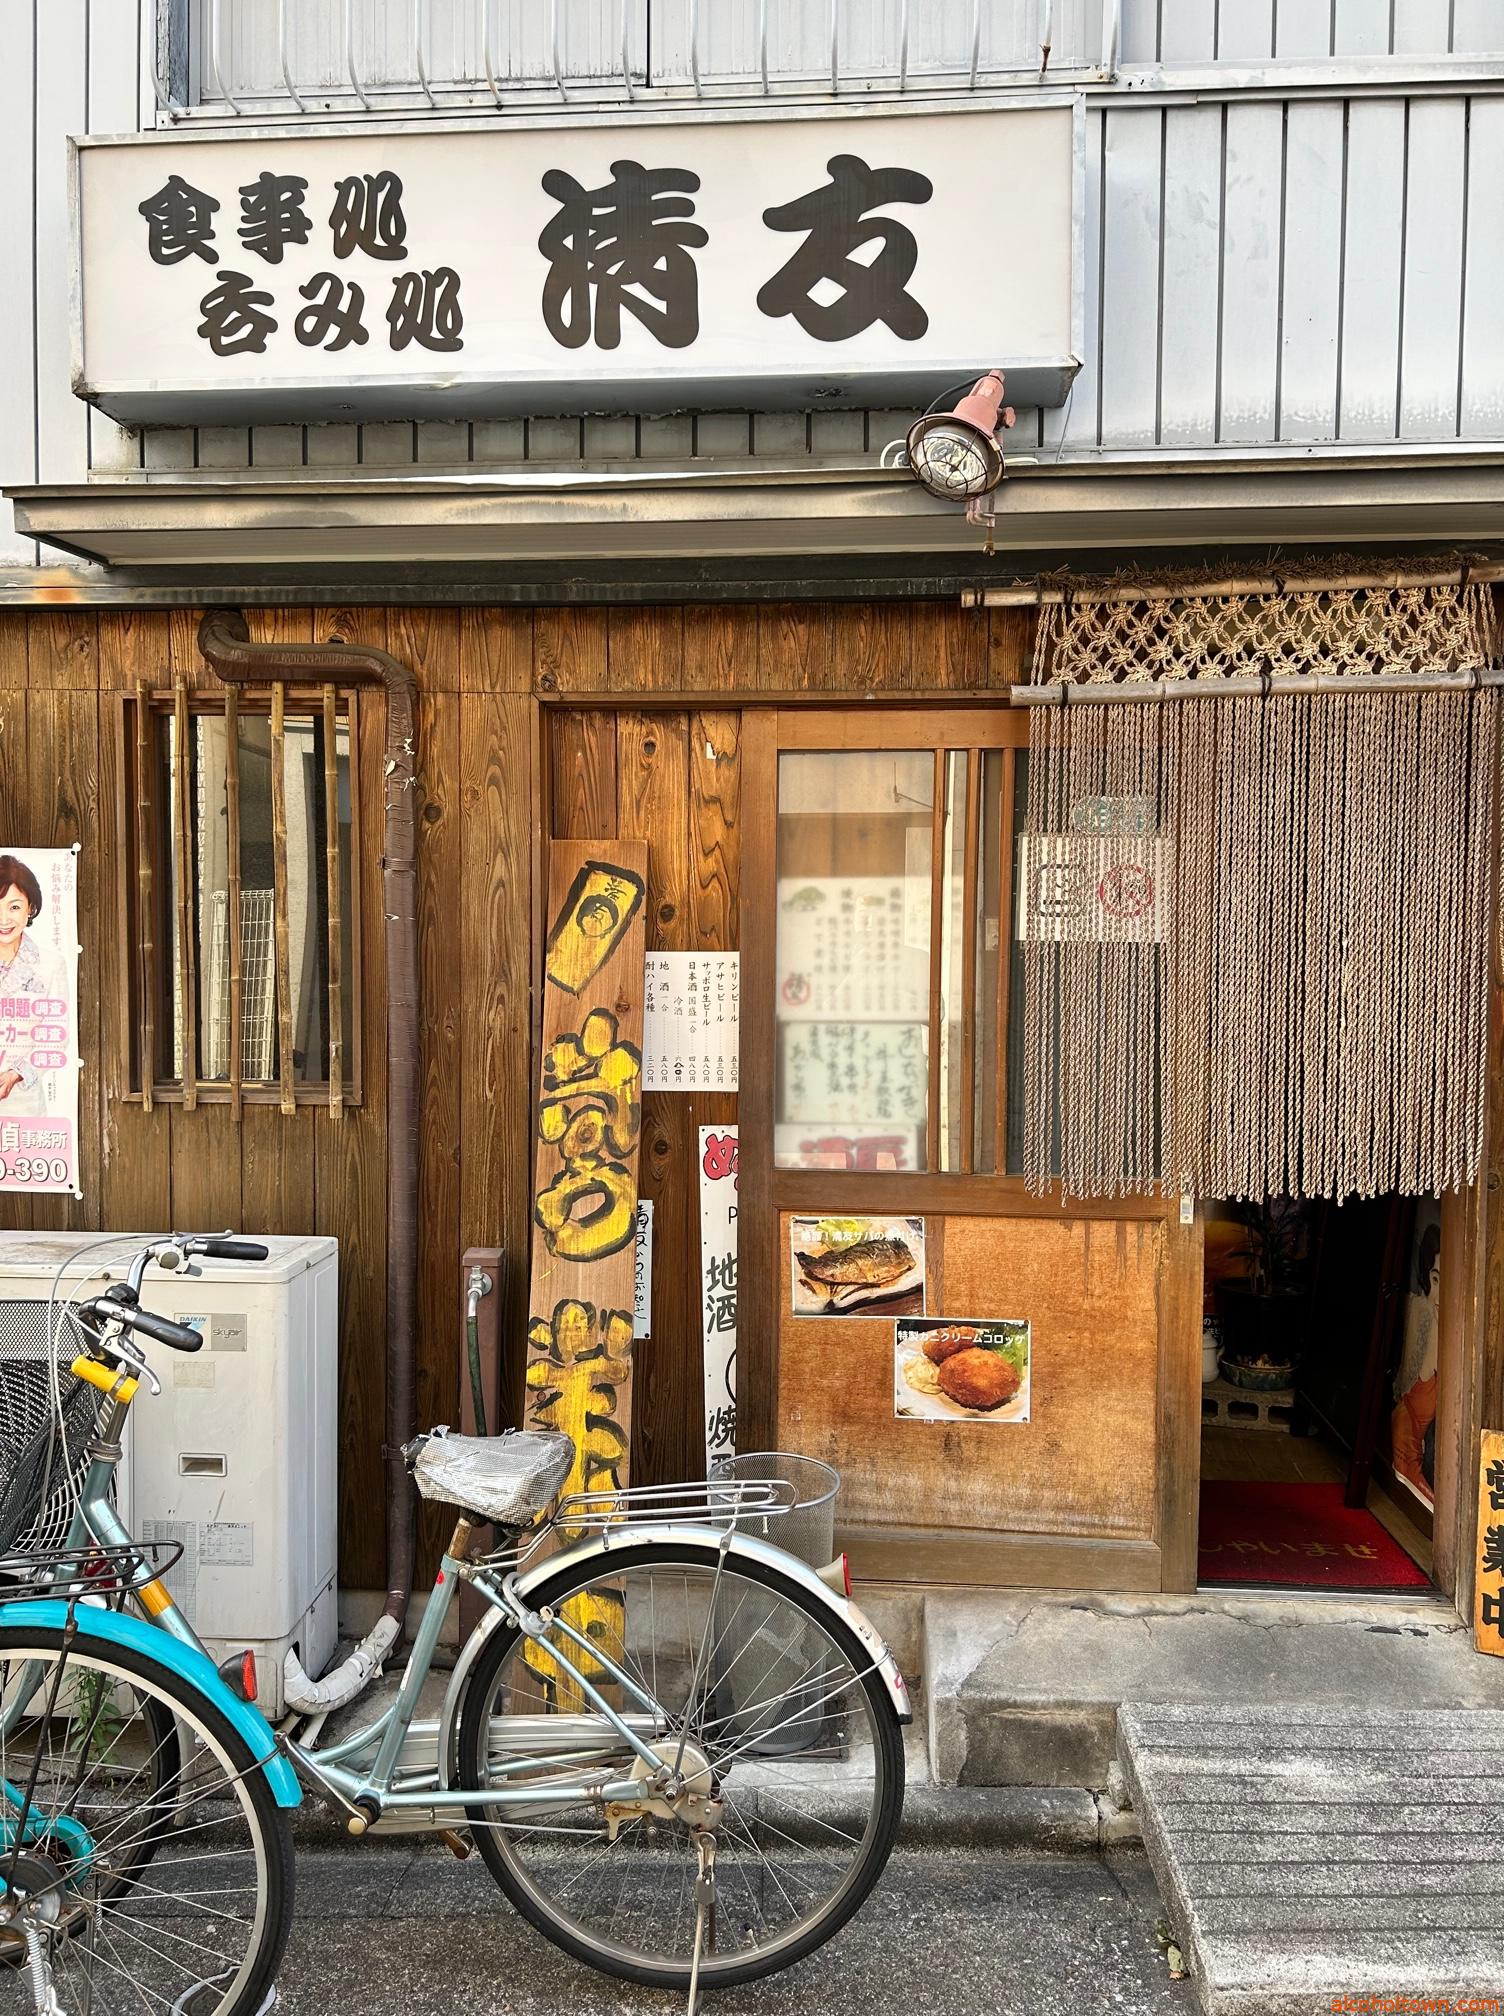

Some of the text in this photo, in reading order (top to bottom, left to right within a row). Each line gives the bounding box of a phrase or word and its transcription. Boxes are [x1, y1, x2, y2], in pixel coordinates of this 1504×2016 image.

[139, 170, 408, 265] 食事処
[538, 154, 934, 351] 清友
[197, 267, 464, 356] 呑み処
[701, 962, 712, 1026] サッポロ生ビール
[716, 962, 725, 1022] アサヒビール
[898, 1331, 1025, 1345] 特製カニクリームコロッケ
